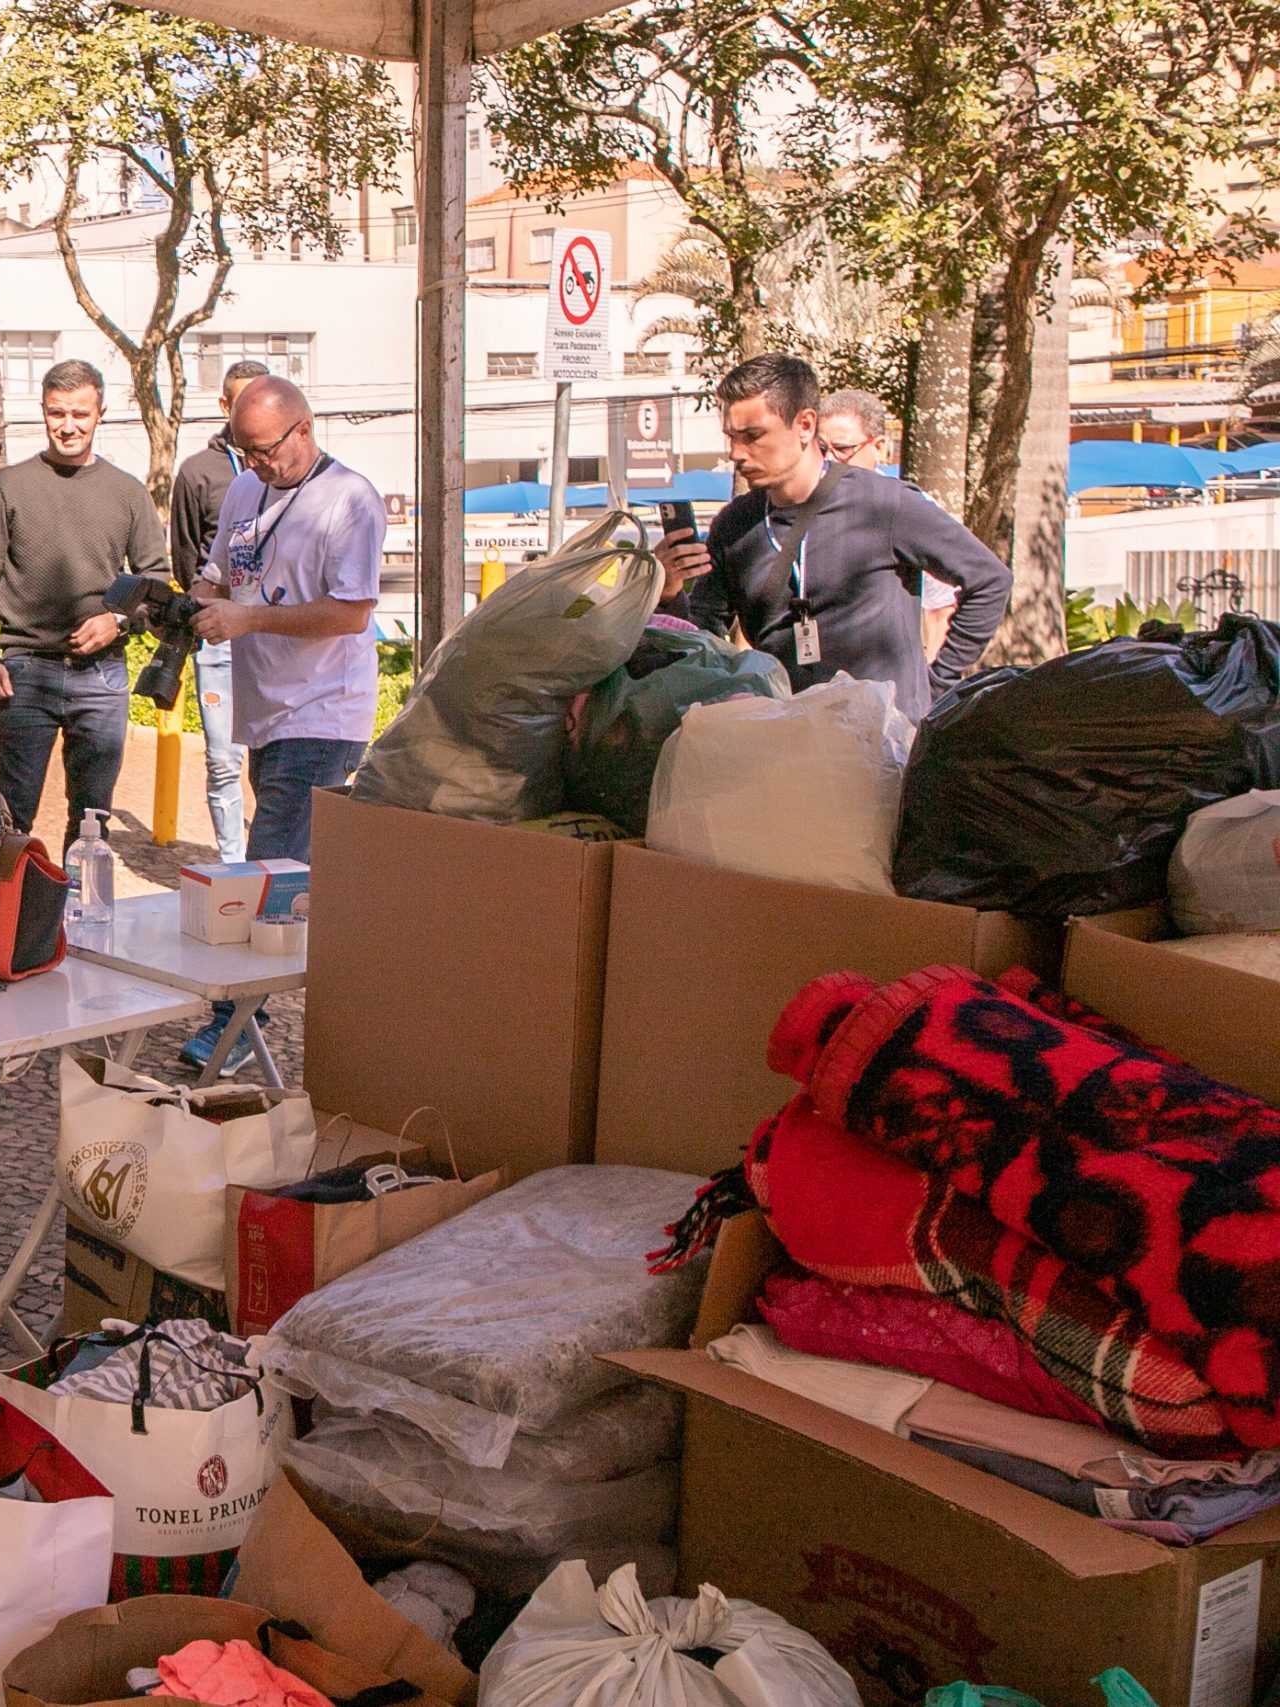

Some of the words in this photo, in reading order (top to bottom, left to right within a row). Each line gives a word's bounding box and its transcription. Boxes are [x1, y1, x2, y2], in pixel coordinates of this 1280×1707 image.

[561, 354, 591, 364] PROIBIDO
[552, 369, 599, 379] MOTOCICLETAS
[474, 538, 545, 547] BIODIESEL
[135, 1507, 203, 1525] TONEL
[208, 1485, 269, 1521] PRIVAD
